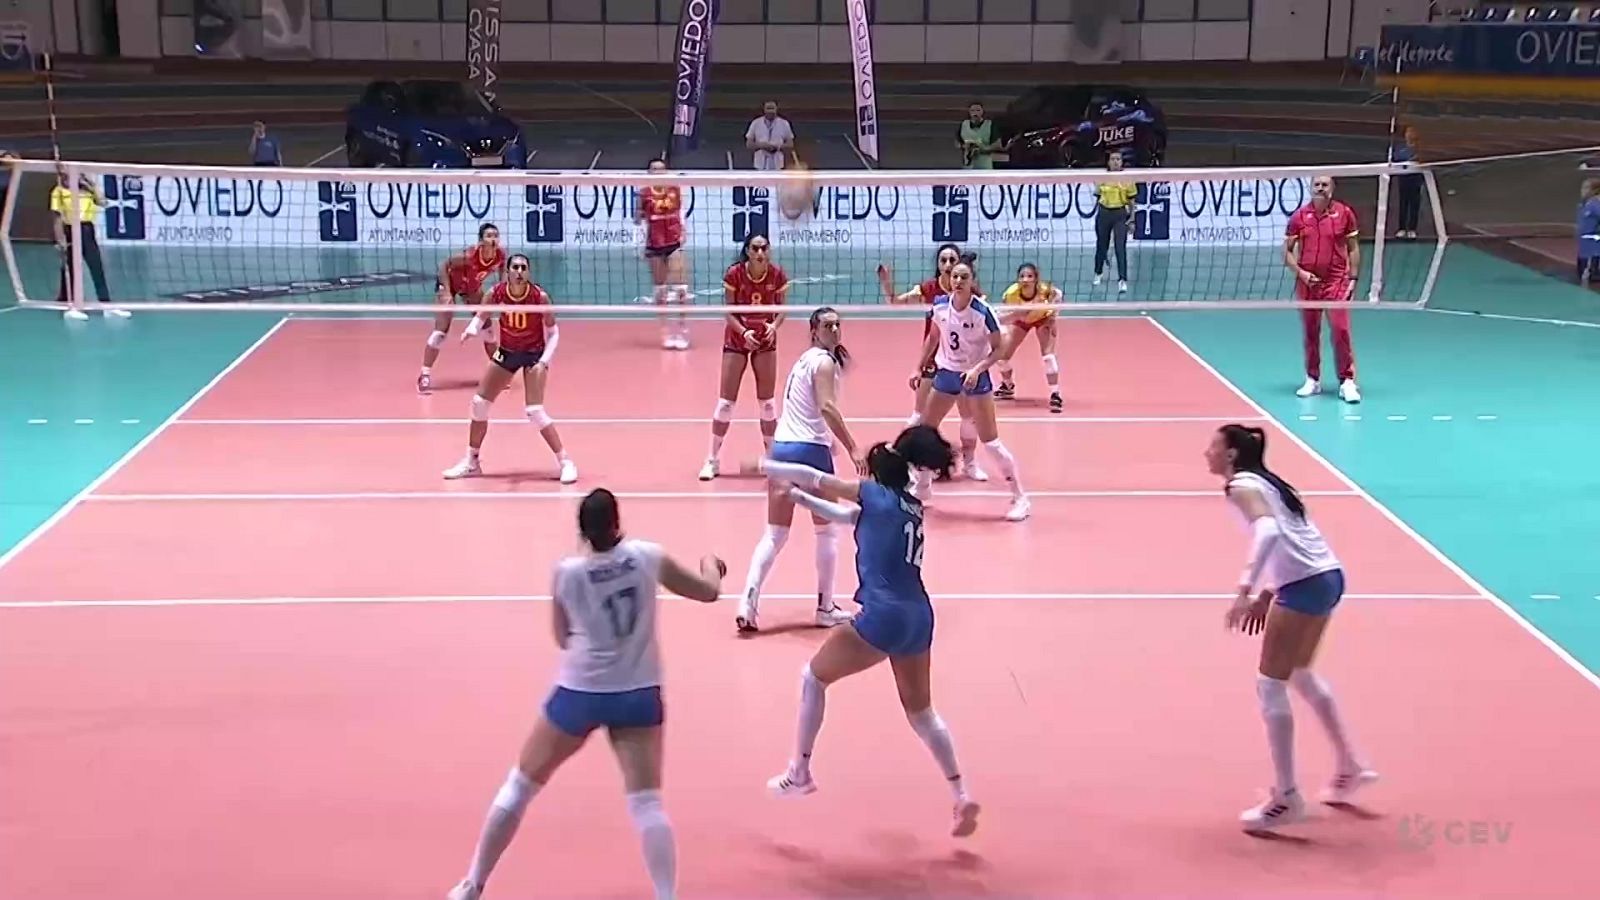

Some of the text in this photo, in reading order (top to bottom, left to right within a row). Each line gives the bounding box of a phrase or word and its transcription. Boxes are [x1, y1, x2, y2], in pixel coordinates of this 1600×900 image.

[468, 8, 482, 79] CYASA
[484, 0, 500, 102] ISSA
[676, 0, 707, 100] OVIEDO
[855, 1, 872, 99] OVIEDO
[1516, 31, 1600, 65] OVIE
[1093, 126, 1135, 147] JUKE
[155, 176, 283, 217] OVIEDO
[367, 182, 491, 219] OVIEDO
[1181, 178, 1304, 219] OVIEDO
[157, 226, 232, 241] AYUNTAMIENTO
[368, 227, 442, 243] AYUNTAMIENTO
[574, 229, 646, 244] AYUNTAMIEN
[780, 229, 850, 243] AYUNTAMIENTO
[979, 228, 1049, 242] AYUNTAMIENTO
[1180, 226, 1251, 240] AYUNTAMIENTO
[507, 311, 527, 329] 10
[950, 331, 959, 350] 3
[601, 586, 638, 638] 17
